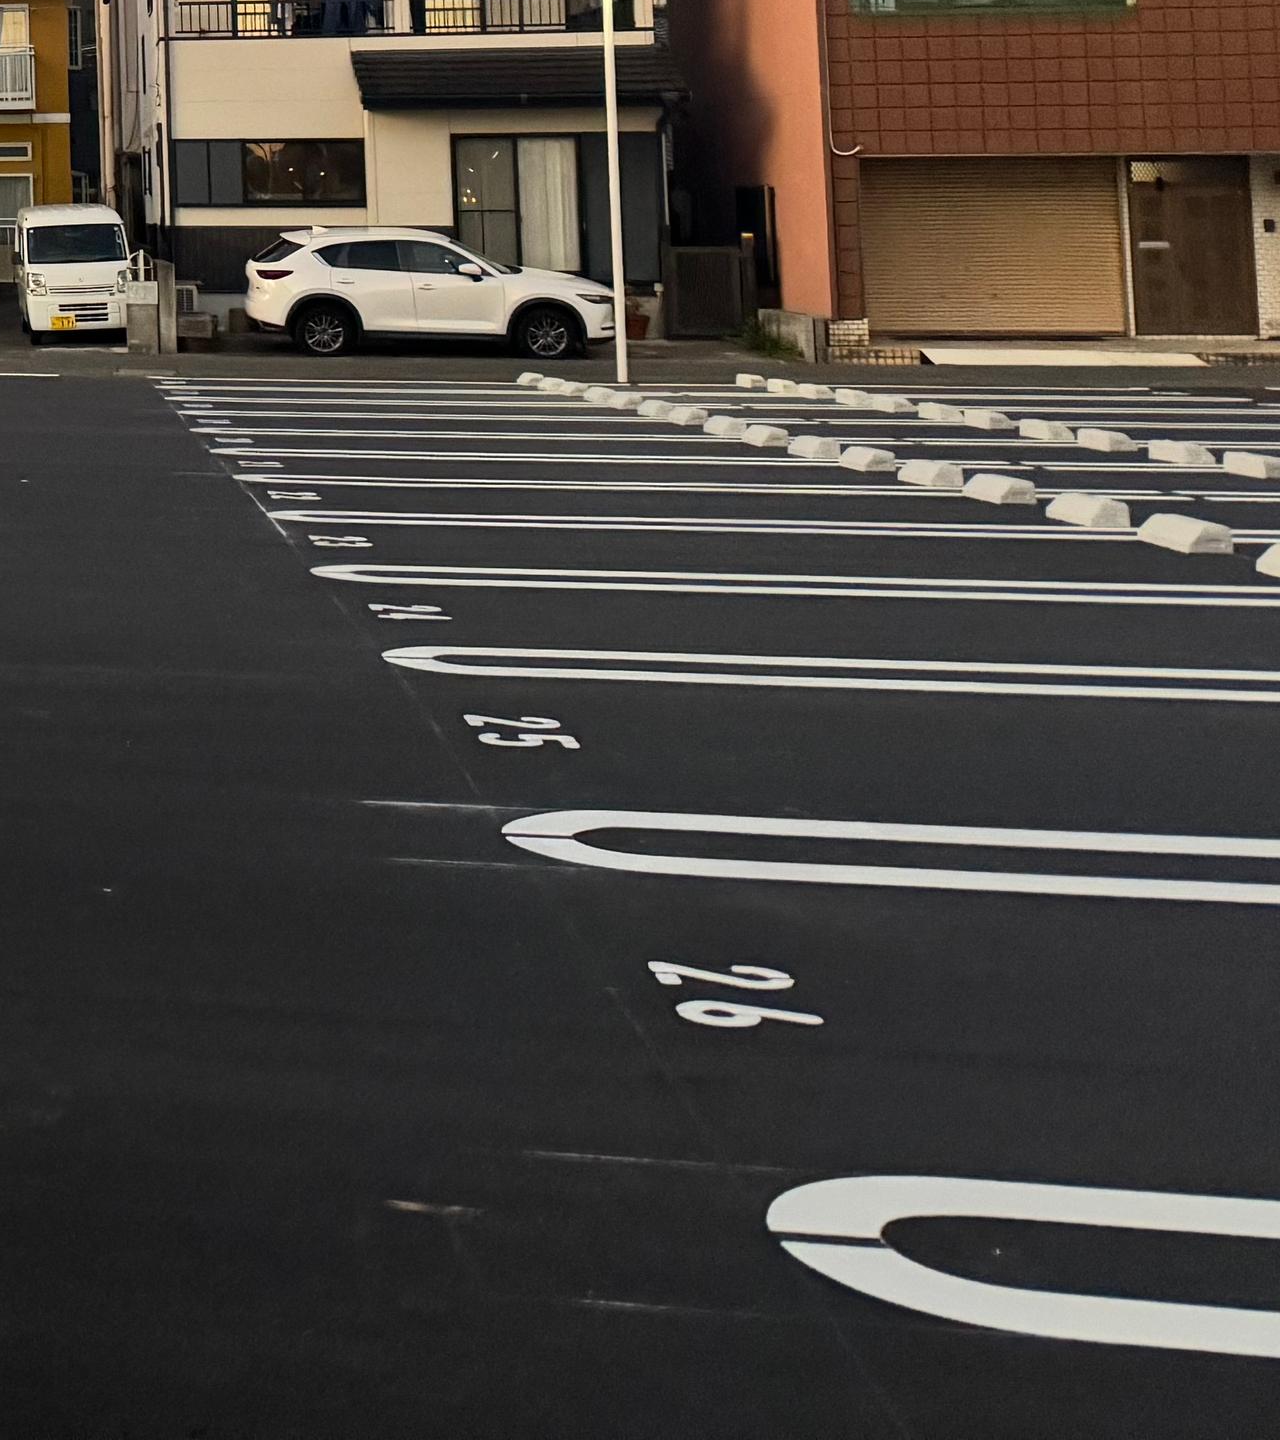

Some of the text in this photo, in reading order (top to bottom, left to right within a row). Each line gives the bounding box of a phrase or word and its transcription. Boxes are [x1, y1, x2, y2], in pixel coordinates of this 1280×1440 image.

[308, 534, 374, 548] 23
[463, 714, 581, 749] 25
[647, 960, 825, 1028] 26
